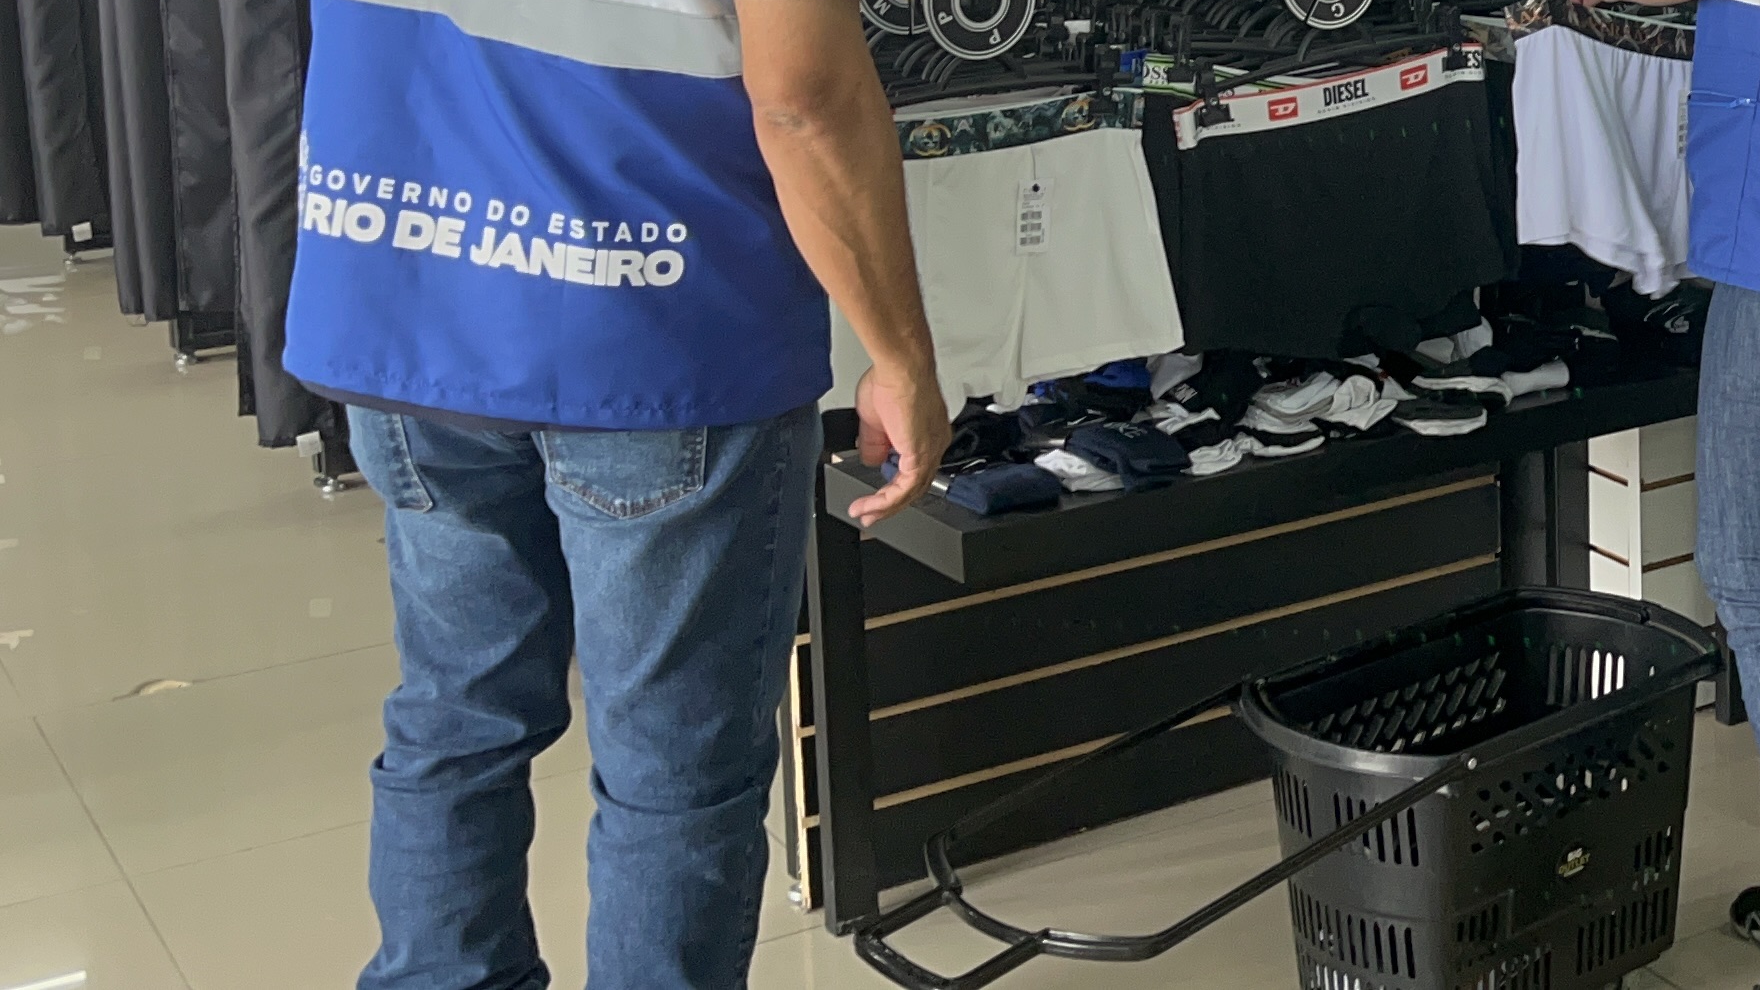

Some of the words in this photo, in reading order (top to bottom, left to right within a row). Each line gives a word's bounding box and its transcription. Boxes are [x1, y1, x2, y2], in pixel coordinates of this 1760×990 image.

[1323, 78, 1369, 107] DIESEL
[304, 192, 386, 242] RIO
[392, 209, 466, 258] DE
[470, 226, 685, 287] JANEIRO
[309, 165, 472, 213] GOVERNO
[487, 199, 530, 227] DO
[547, 212, 688, 243] ESTADO
